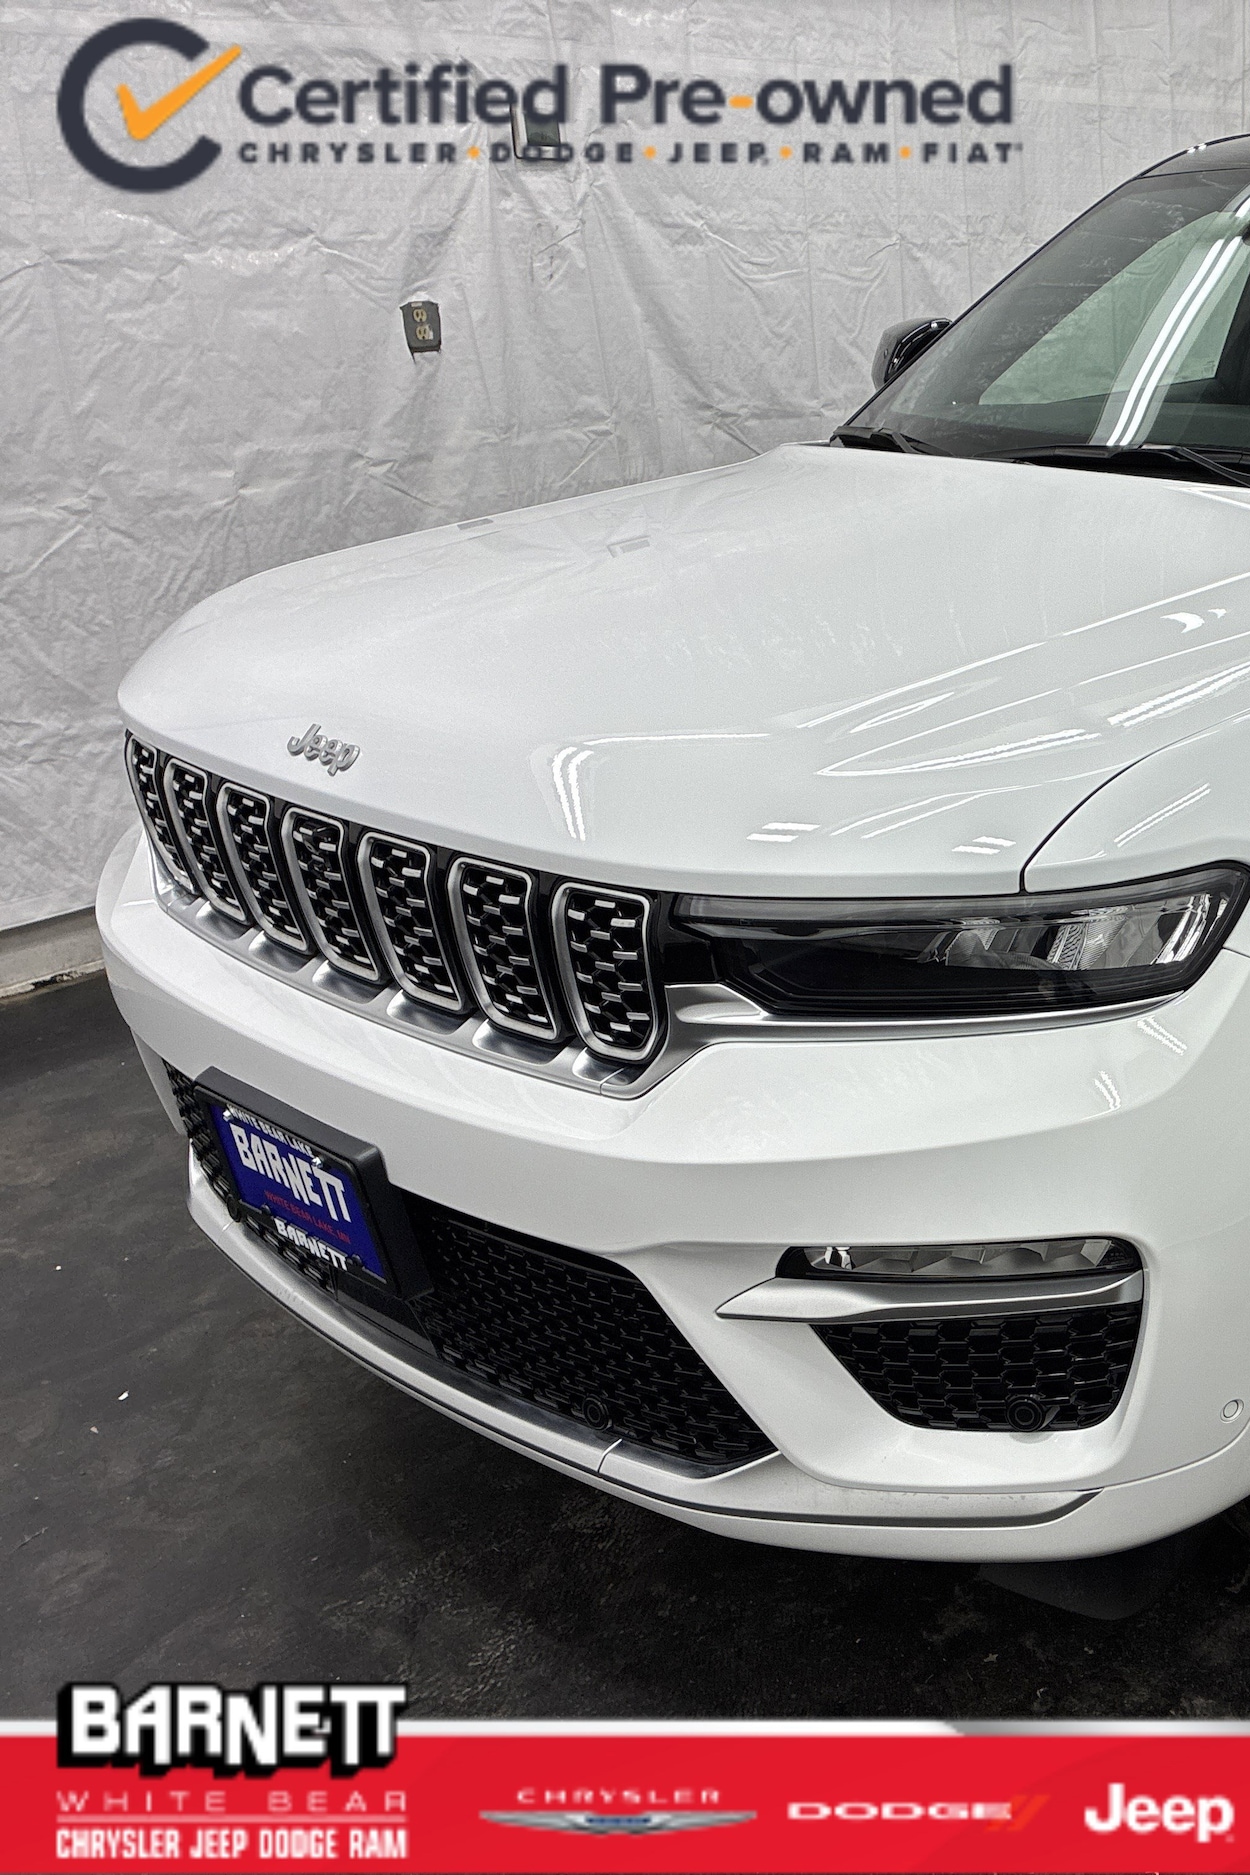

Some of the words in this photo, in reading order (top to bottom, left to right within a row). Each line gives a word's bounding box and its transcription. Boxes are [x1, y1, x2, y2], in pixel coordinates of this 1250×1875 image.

[287, 723, 360, 776] Jeep
[258, 1120, 288, 1145] BEAR
[285, 1134, 315, 1158] LAKE
[230, 1123, 352, 1223] BARNETT
[274, 1217, 348, 1271] BARNETT
